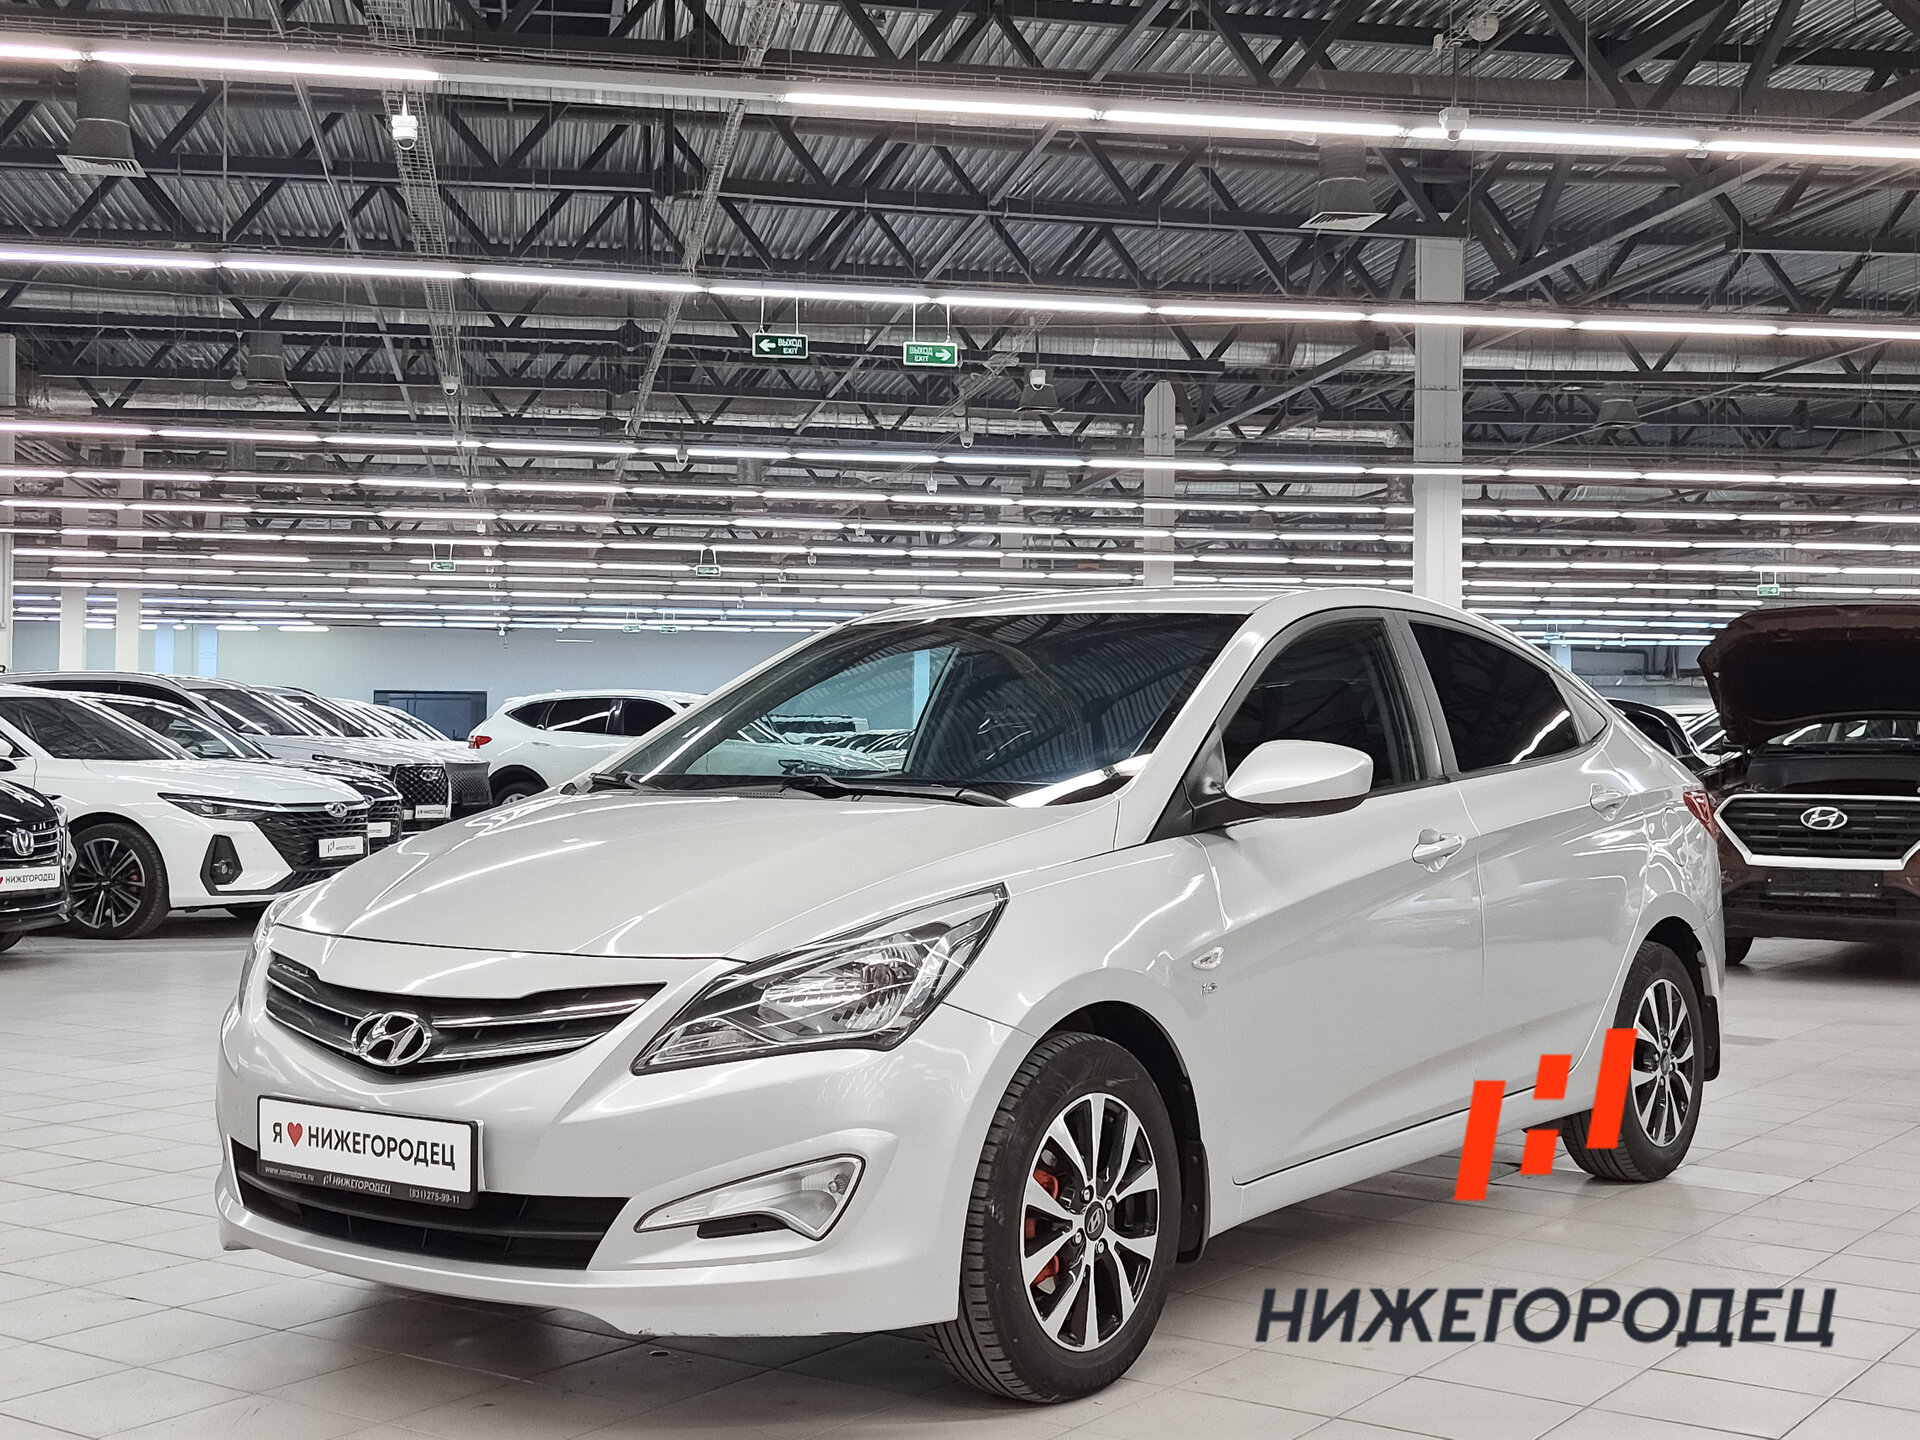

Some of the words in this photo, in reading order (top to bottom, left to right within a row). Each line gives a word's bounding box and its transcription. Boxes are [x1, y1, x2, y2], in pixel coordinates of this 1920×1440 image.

[778, 338, 802, 348] ВЫХОД
[909, 346, 933, 357] ВЫХОД
[5, 873, 56, 884] НИЖЕГОРОДЕЦ
[273, 1121, 283, 1143] Я
[308, 1125, 456, 1171] НИЖЕГОРОДЕЦ
[332, 1176, 392, 1195] НИЖЕГОРОДЕЦ
